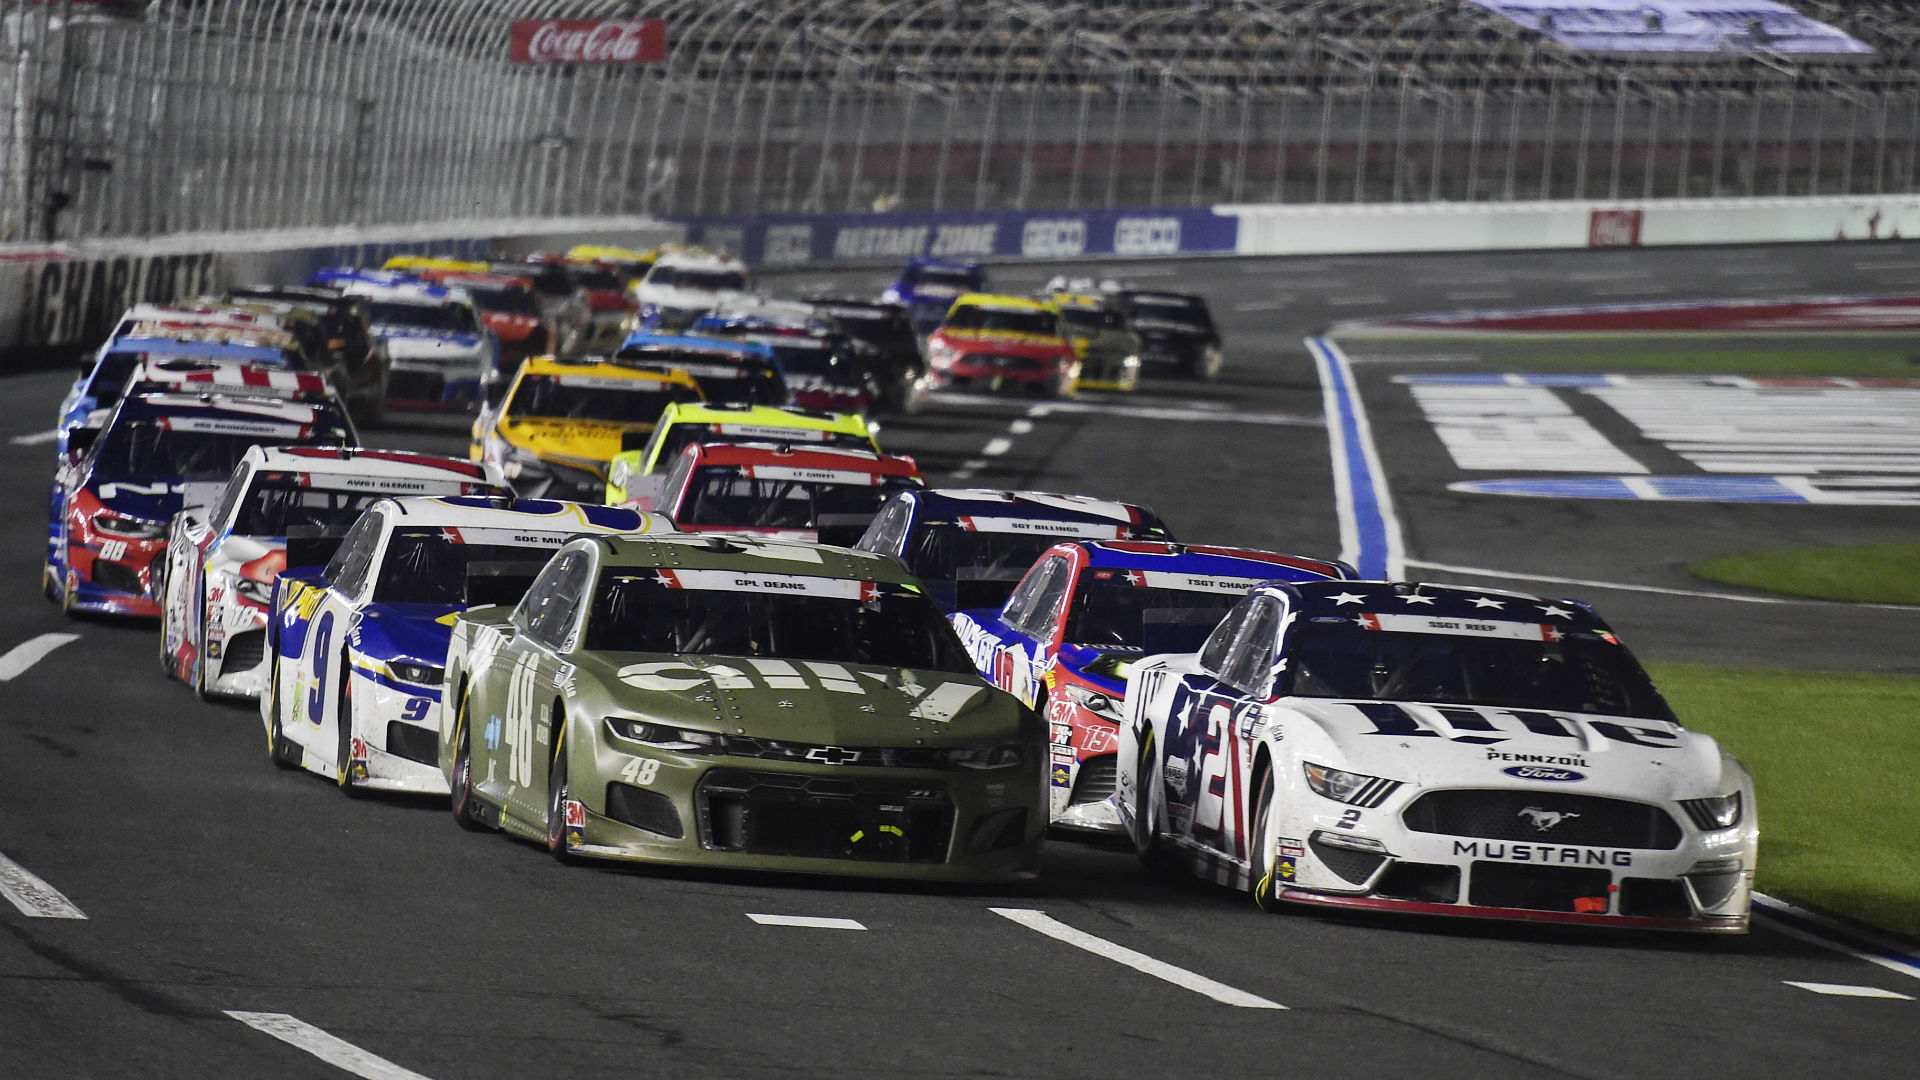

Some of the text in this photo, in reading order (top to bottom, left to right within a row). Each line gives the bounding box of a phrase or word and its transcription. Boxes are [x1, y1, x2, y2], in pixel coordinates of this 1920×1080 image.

[1022, 218, 1087, 257] GEICO
[1113, 218, 1181, 254] GEICO
[1034, 524, 1079, 533] BILLINGS
[735, 579, 806, 591] CPL DEANS
[1187, 578, 1214, 588] TSGT
[1428, 620, 1497, 633] SSGT REEP
[308, 610, 336, 726] 9
[400, 698, 433, 721] 9
[505, 649, 540, 789] 48
[351, 738, 367, 758] 3M
[1196, 700, 1231, 832] 2
[1487, 752, 1591, 768] PENNZOIL
[621, 758, 660, 787] 48
[1517, 766, 1571, 780] Ford
[567, 801, 585, 826] 3M
[1335, 808, 1362, 830] 2
[1452, 840, 1633, 868] MUSTANG
